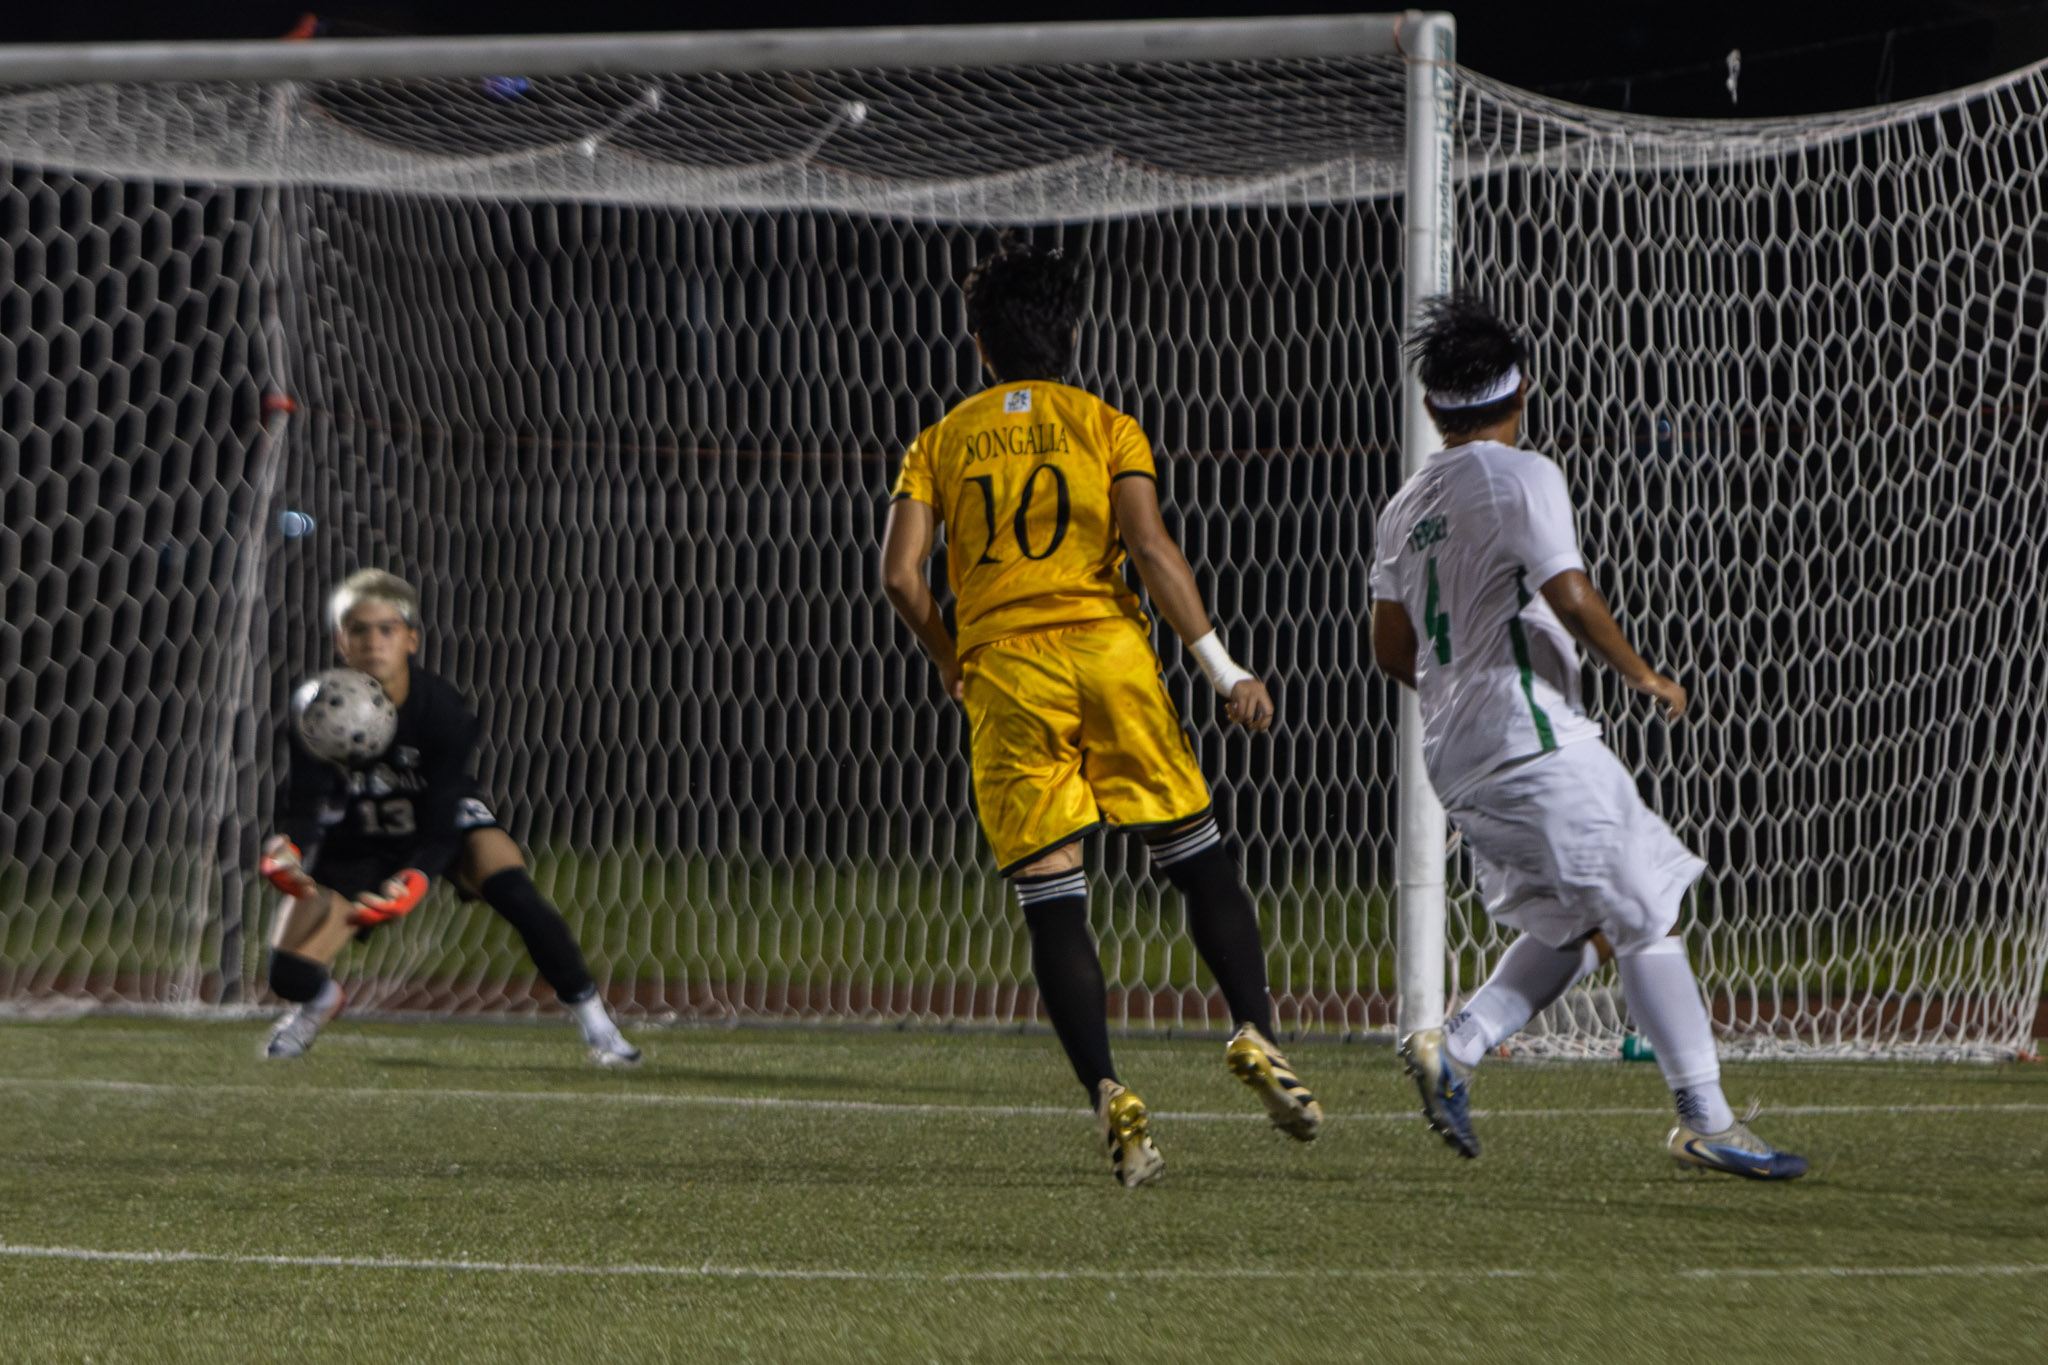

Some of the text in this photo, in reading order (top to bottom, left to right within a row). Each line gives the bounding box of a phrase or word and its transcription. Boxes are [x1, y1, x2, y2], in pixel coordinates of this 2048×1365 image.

[963, 463, 1071, 566] 10
[1424, 556, 1452, 666] 4
[357, 799, 416, 835] 13
